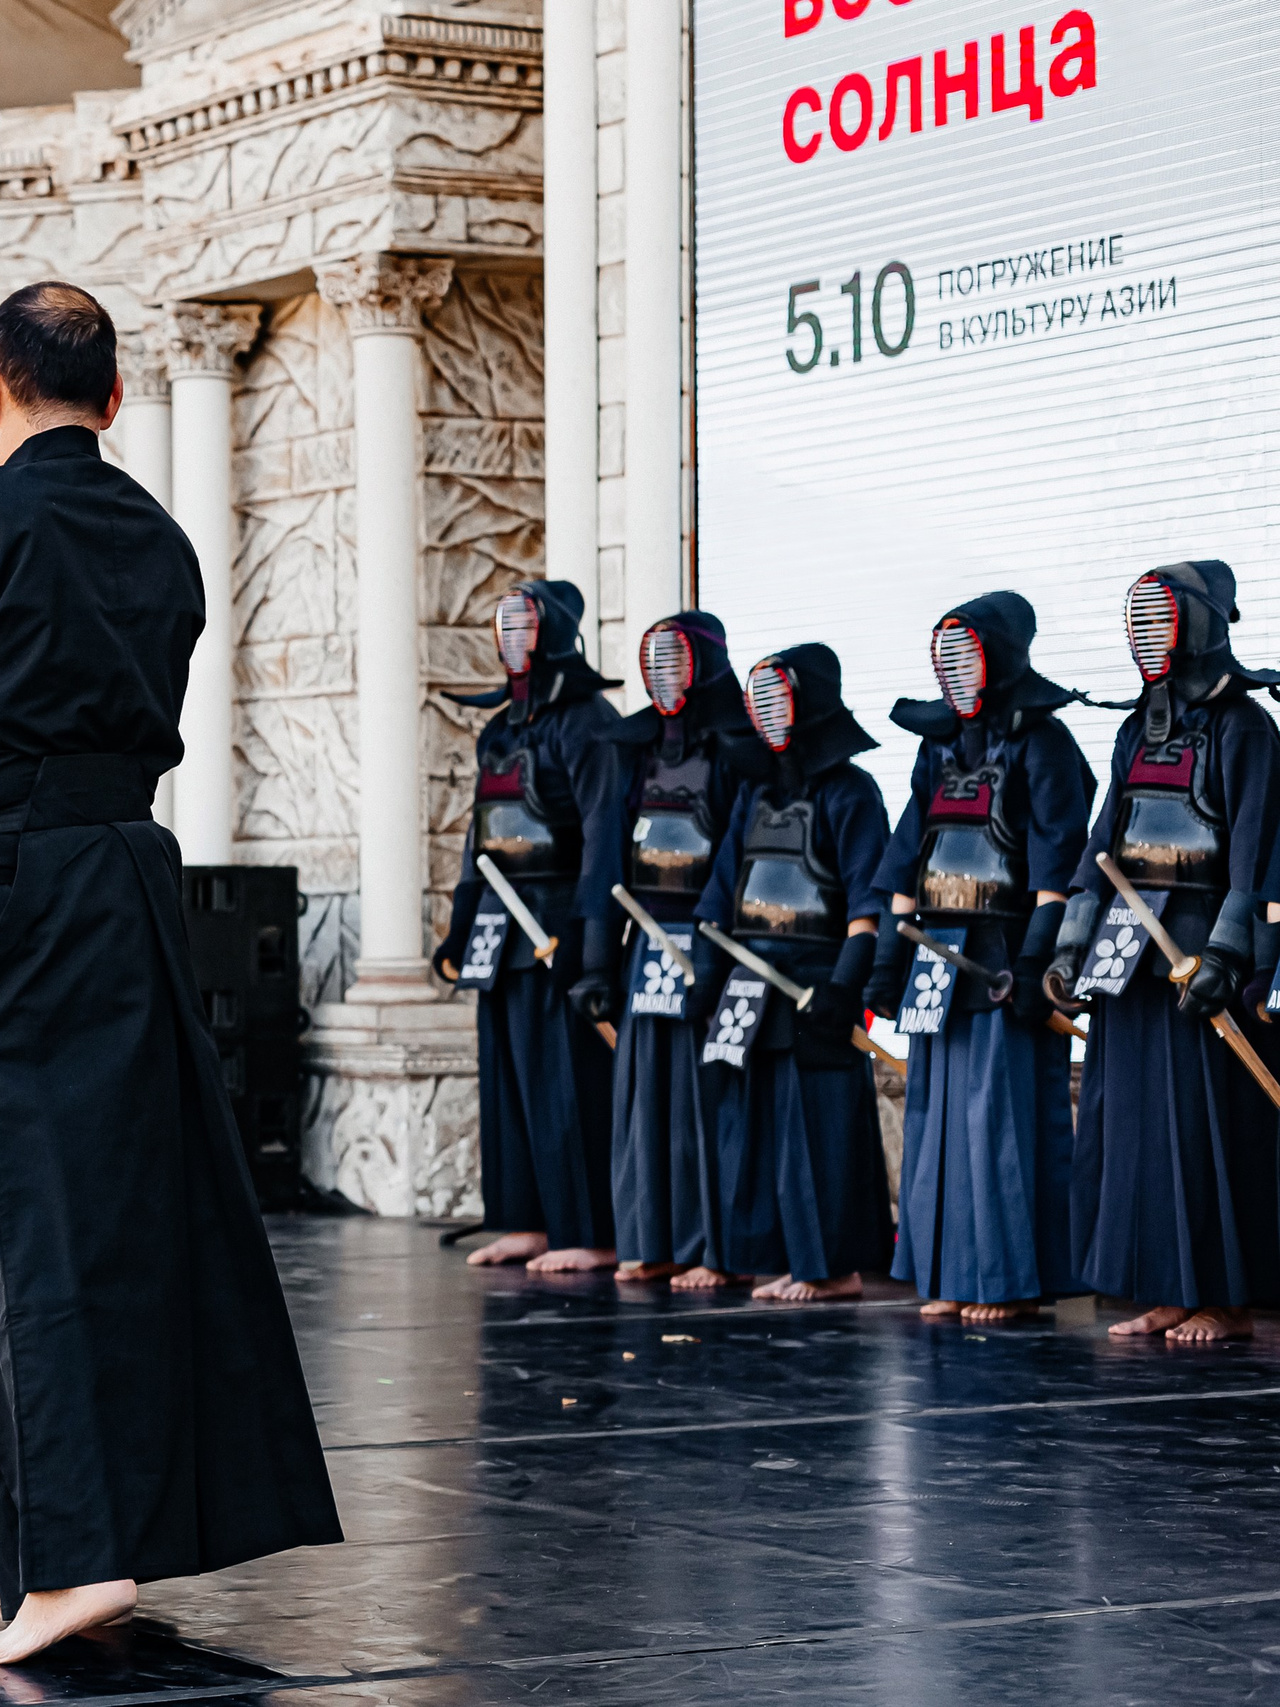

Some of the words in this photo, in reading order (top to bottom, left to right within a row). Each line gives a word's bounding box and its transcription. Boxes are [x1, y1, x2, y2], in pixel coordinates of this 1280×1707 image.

[783, 9, 1096, 163] солнца
[938, 234, 1124, 299] ПОГРУЖЕНИЕ
[939, 321, 953, 350] В
[962, 294, 1093, 346] КУЛЬТУРУ
[1101, 276, 1177, 322] АЗИИ
[786, 260, 915, 374] 5.10
